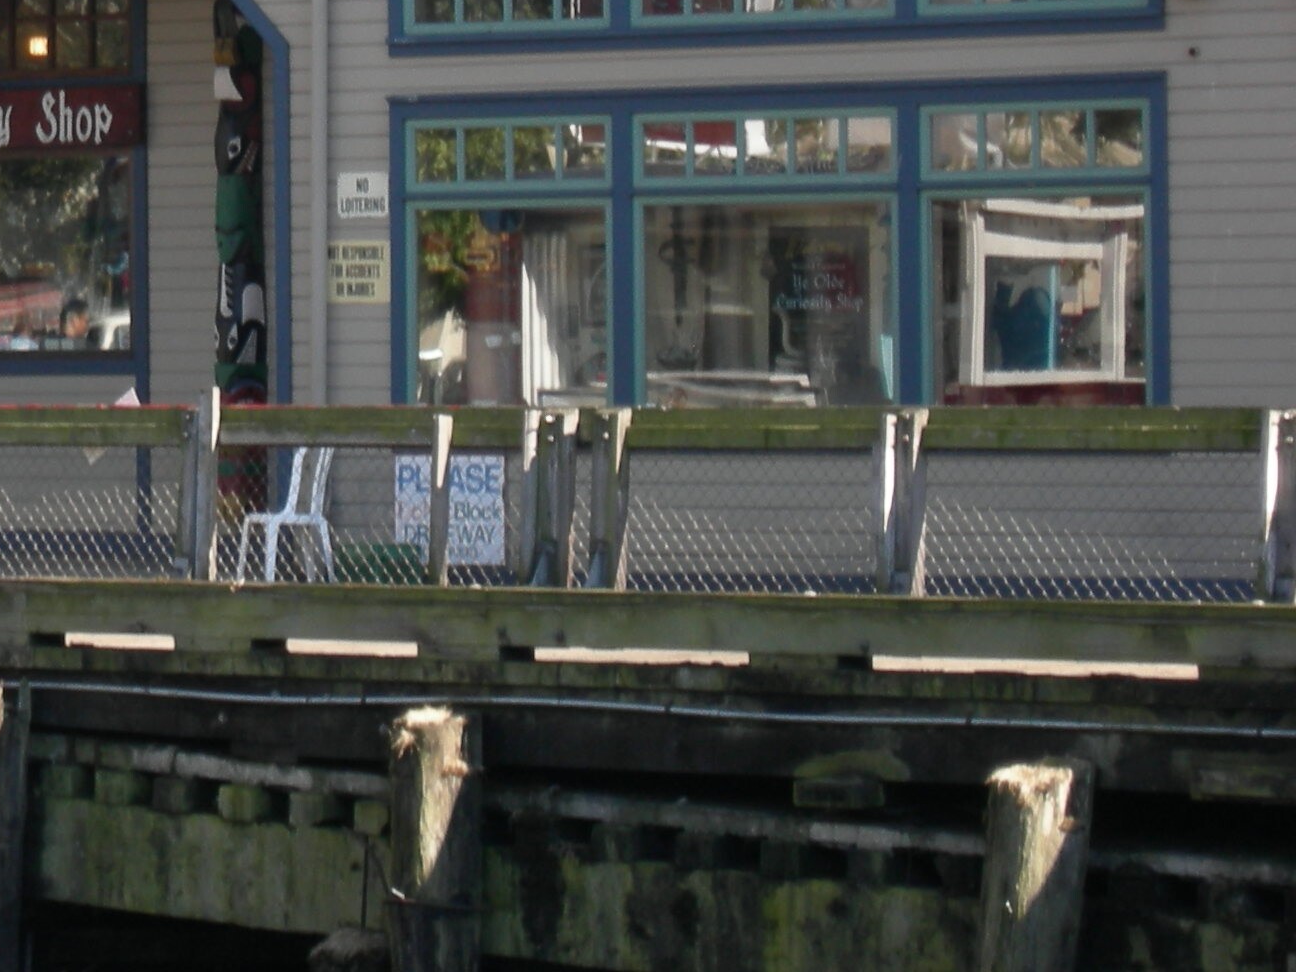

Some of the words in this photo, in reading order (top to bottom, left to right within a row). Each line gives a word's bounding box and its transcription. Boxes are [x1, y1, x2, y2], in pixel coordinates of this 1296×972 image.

[35, 89, 113, 145] Shop
[356, 177, 370, 194] NO
[340, 196, 386, 214] LOITERING
[396, 462, 502, 494] PLASE
